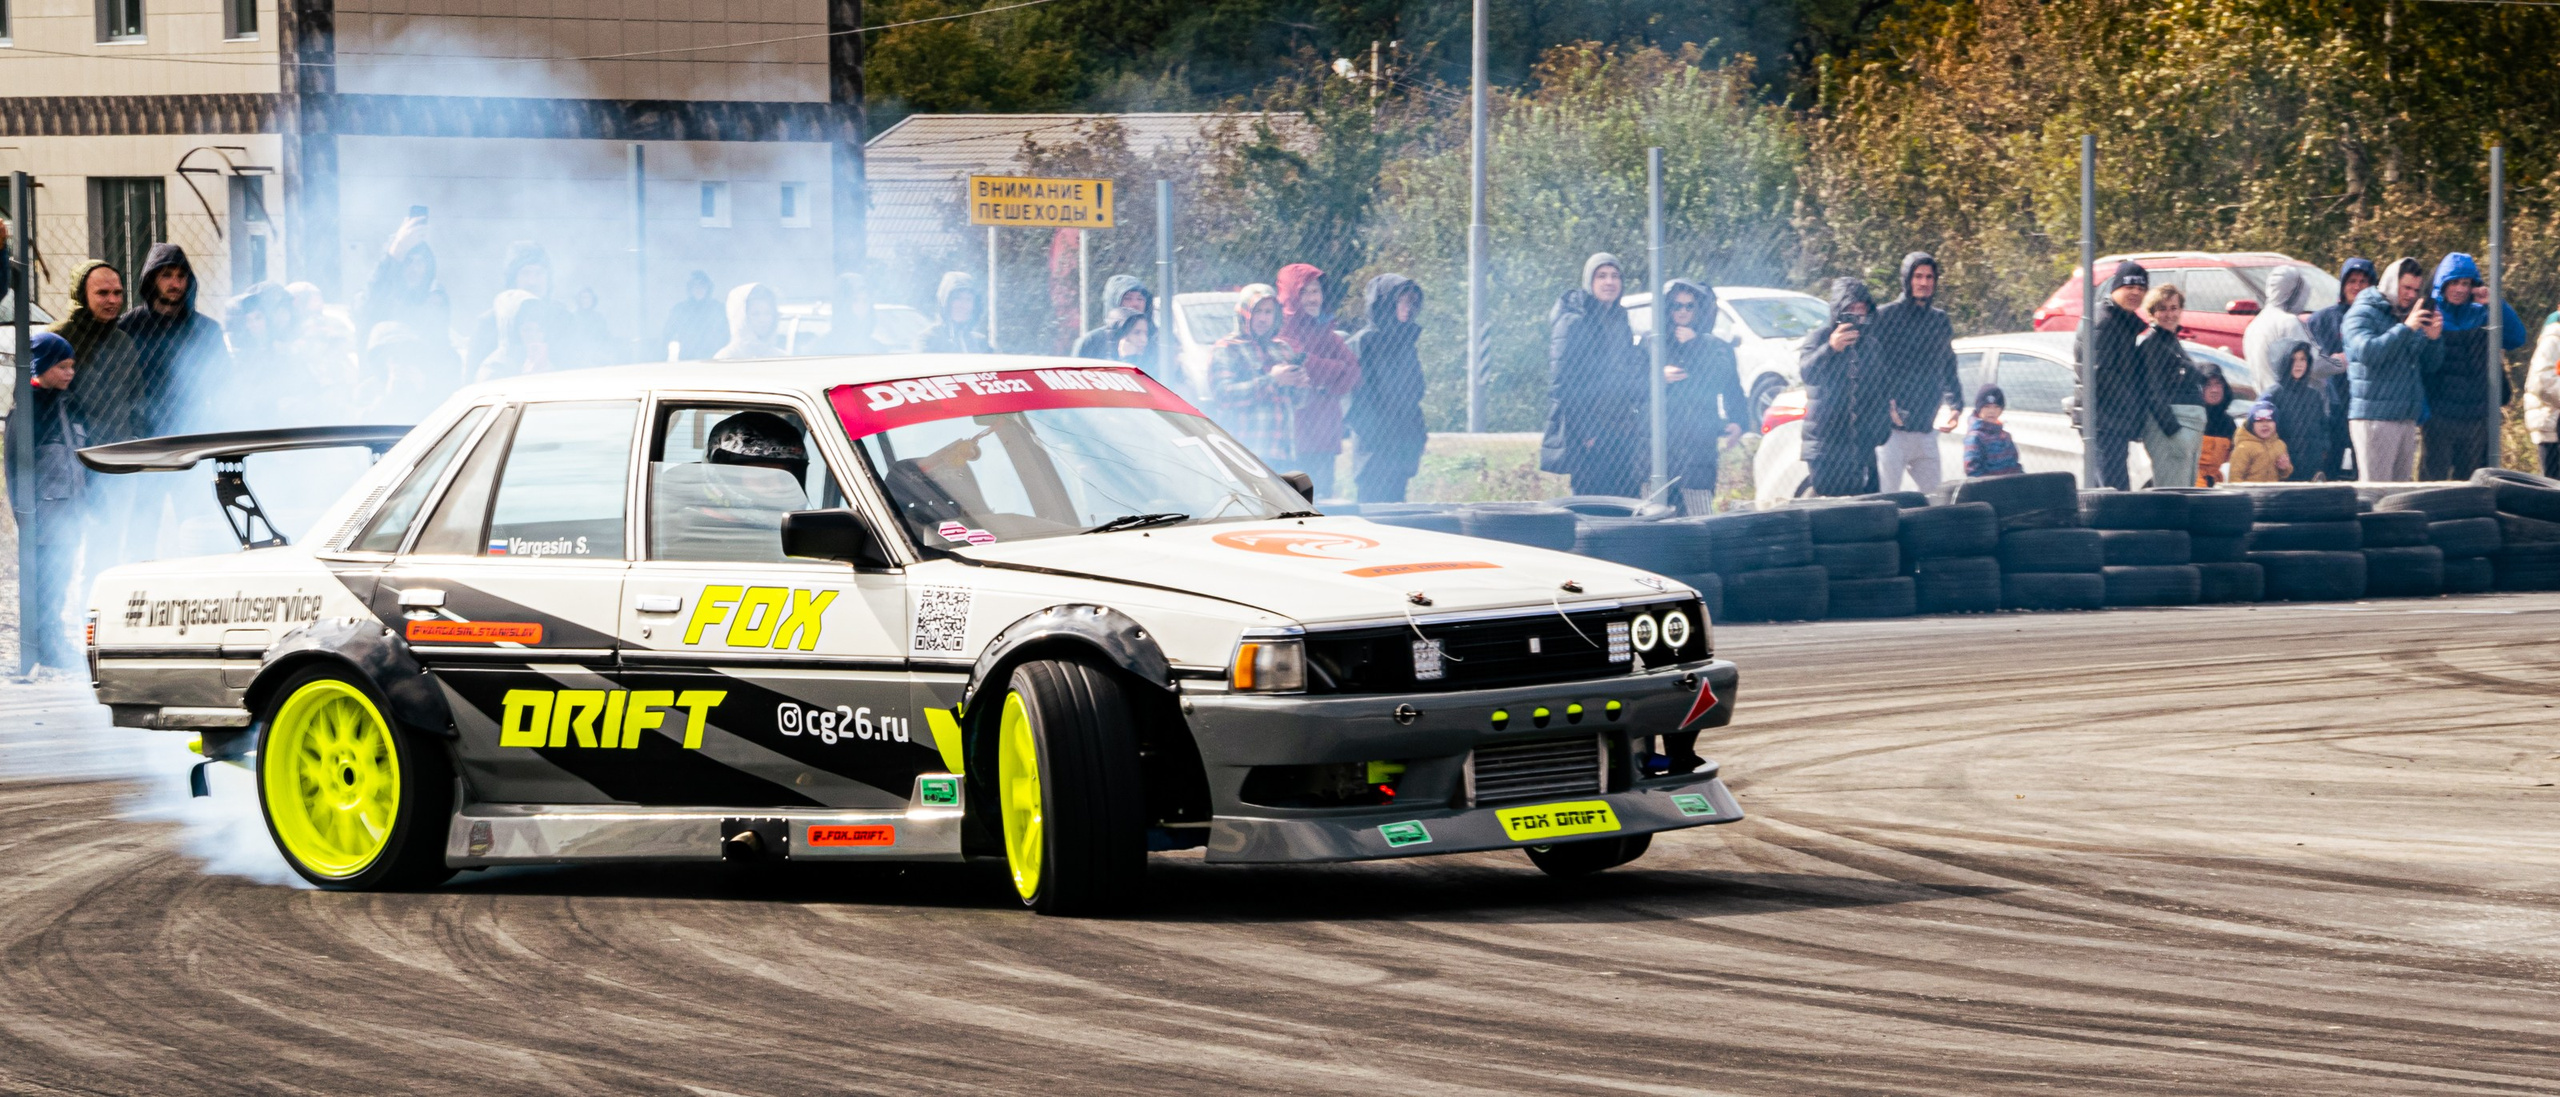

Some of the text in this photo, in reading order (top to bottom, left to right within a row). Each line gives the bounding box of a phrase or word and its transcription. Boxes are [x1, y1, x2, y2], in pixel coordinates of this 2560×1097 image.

[978, 181, 1083, 200] ВНИМАНИЕ
[978, 203, 1088, 222] ПЕШЕХОДЫ
[861, 373, 987, 412] DRIFT
[979, 378, 1034, 395] 2021
[1034, 369, 1147, 394] MATSURI
[1170, 433, 1269, 483] 70
[508, 535, 590, 558] Vargasin S.
[124, 588, 324, 636] #vargasautoservice
[684, 584, 840, 651] FOX
[500, 689, 728, 749] DRIFT
[806, 704, 909, 745] cg26.ru
[1510, 809, 1607, 831] FOX DRIFT
